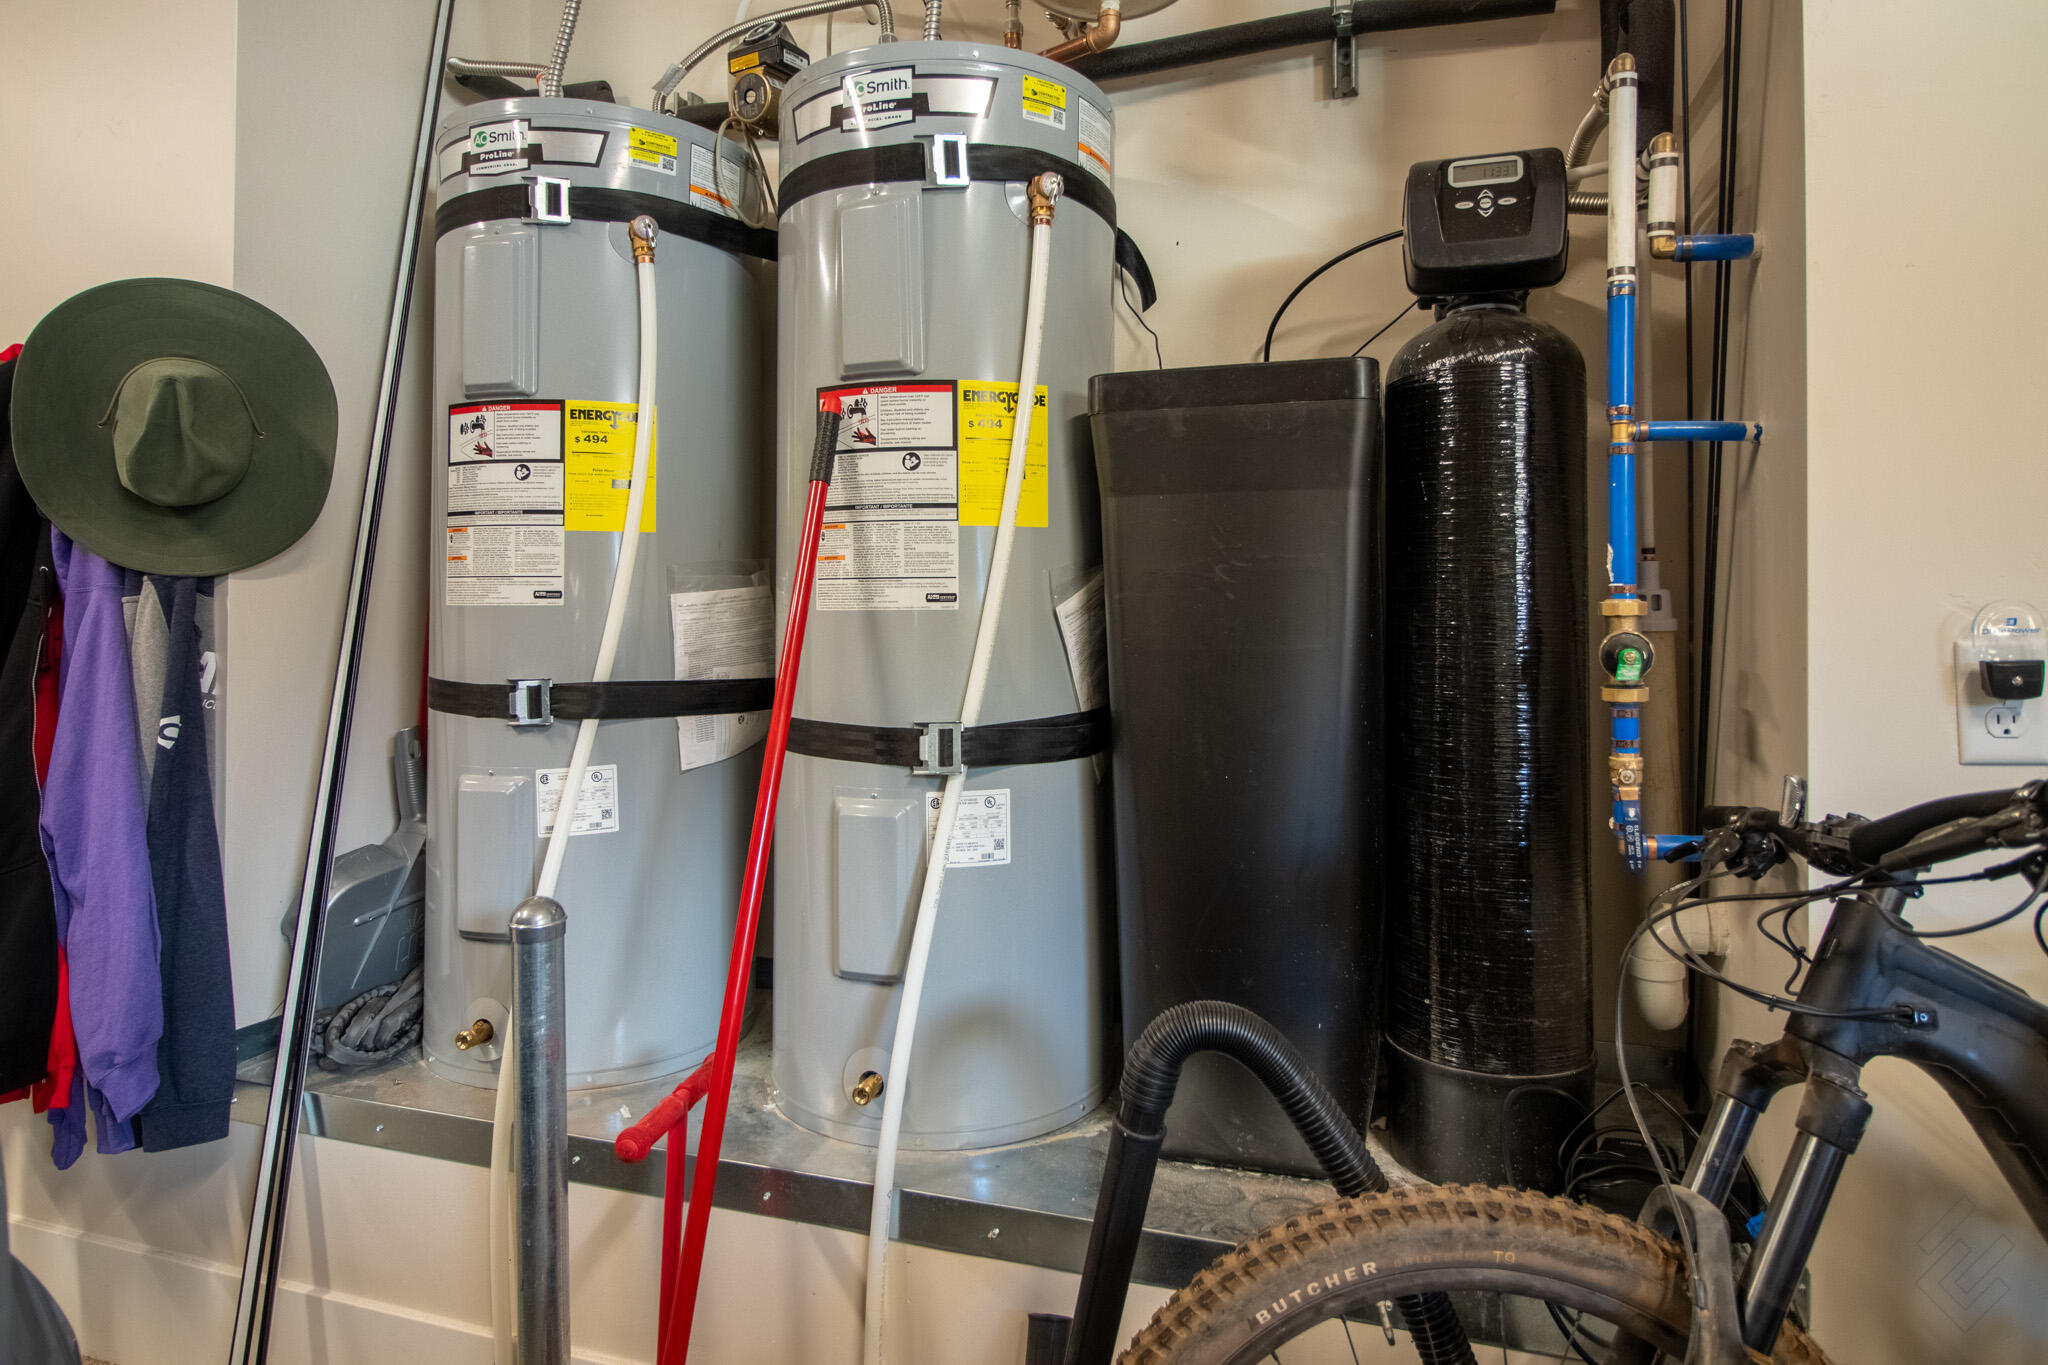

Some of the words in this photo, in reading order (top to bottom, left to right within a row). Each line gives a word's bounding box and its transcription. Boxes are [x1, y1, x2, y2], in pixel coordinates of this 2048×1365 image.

[866, 77, 908, 94] Smith
[857, 101, 895, 113] roLine
[480, 151, 514, 161] ProLine
[977, 419, 1003, 429] 494
[584, 435, 608, 444] 494
[1255, 1260, 1378, 1325] BUTCHER
